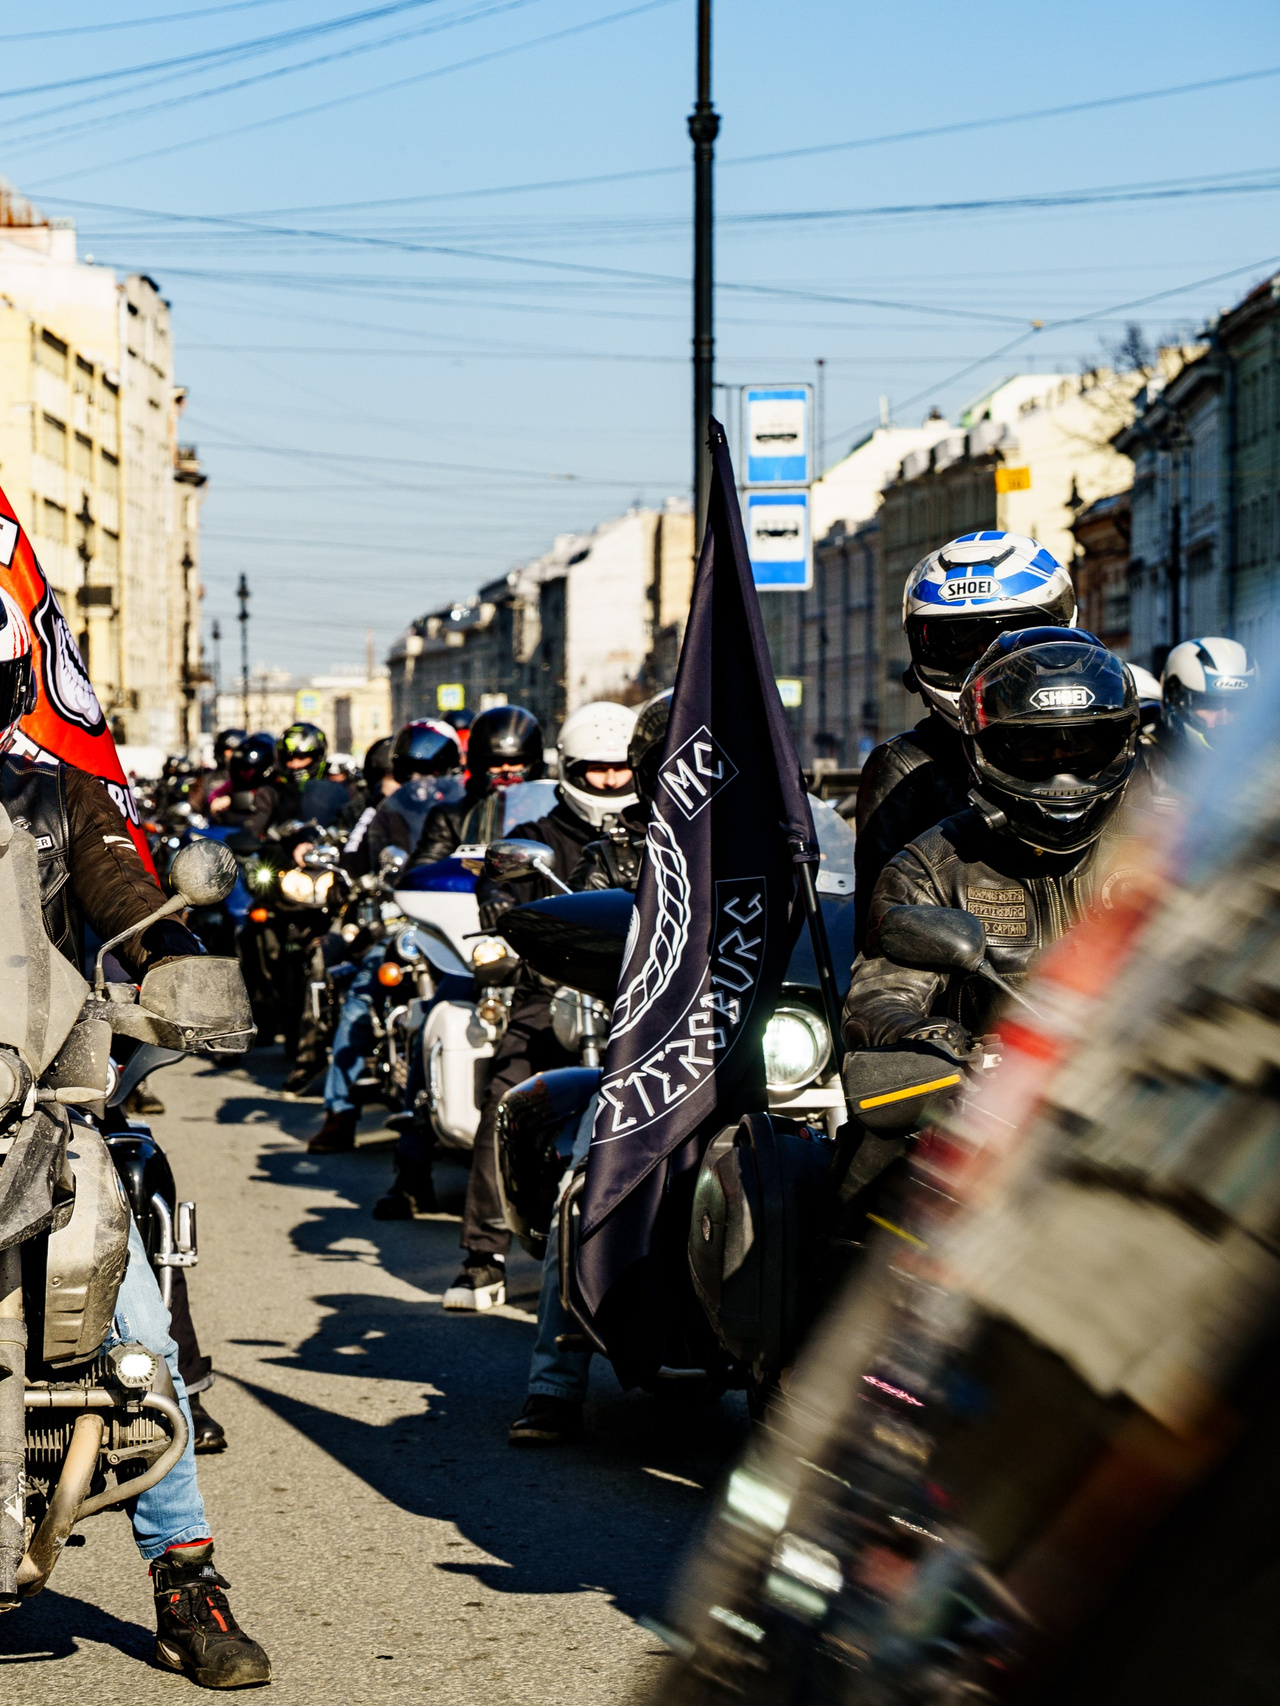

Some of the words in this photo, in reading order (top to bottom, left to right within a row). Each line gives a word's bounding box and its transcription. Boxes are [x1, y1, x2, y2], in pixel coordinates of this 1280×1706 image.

[948, 581, 991, 596] SHOEI
[1039, 690, 1087, 706] SHOEI
[663, 741, 724, 810] MC
[993, 924, 1024, 935] CAPTAIN
